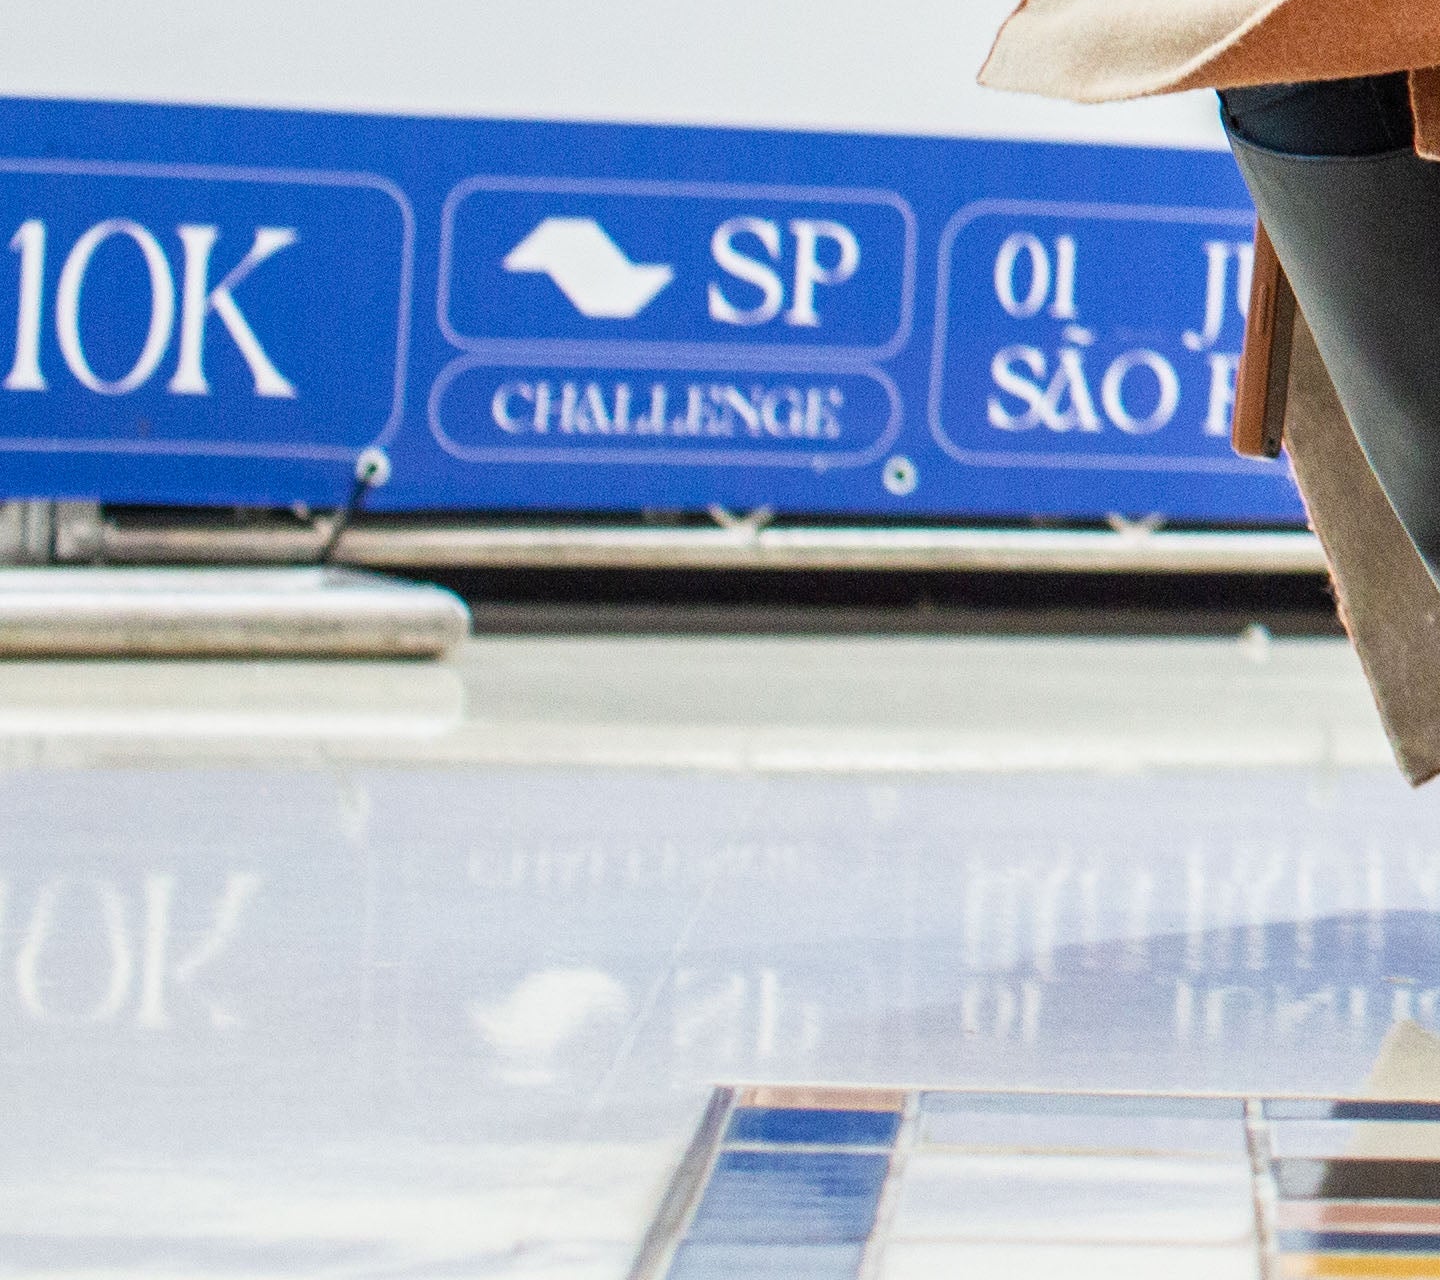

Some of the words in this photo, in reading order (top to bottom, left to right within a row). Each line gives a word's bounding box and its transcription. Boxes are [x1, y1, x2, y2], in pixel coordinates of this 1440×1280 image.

[3, 217, 300, 400] 10K
[706, 212, 864, 328] SP
[490, 377, 847, 440] CHALLENGE
[986, 322, 1182, 436] SÃO
